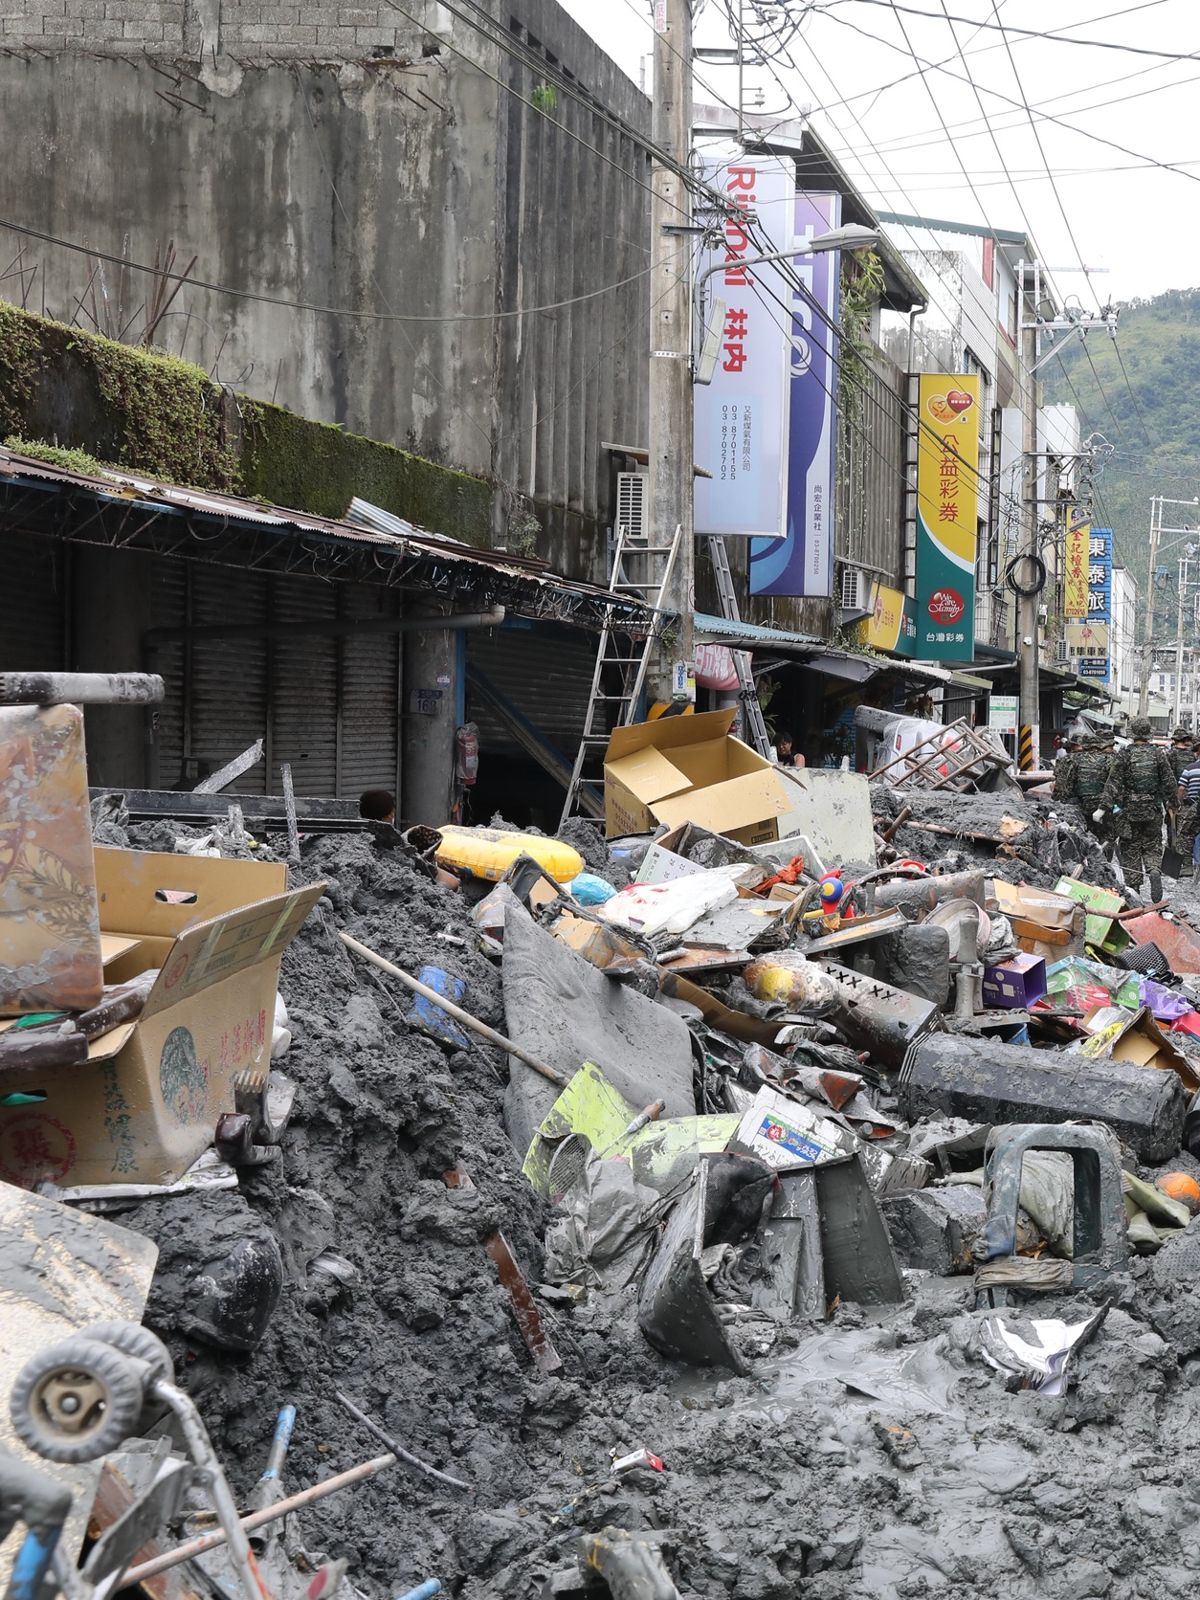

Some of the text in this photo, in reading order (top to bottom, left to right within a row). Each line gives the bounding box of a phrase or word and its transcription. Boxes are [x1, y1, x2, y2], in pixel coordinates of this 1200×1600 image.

[938, 432, 960, 523] 公益彩券
[926, 632, 964, 643] 台灣彩券
